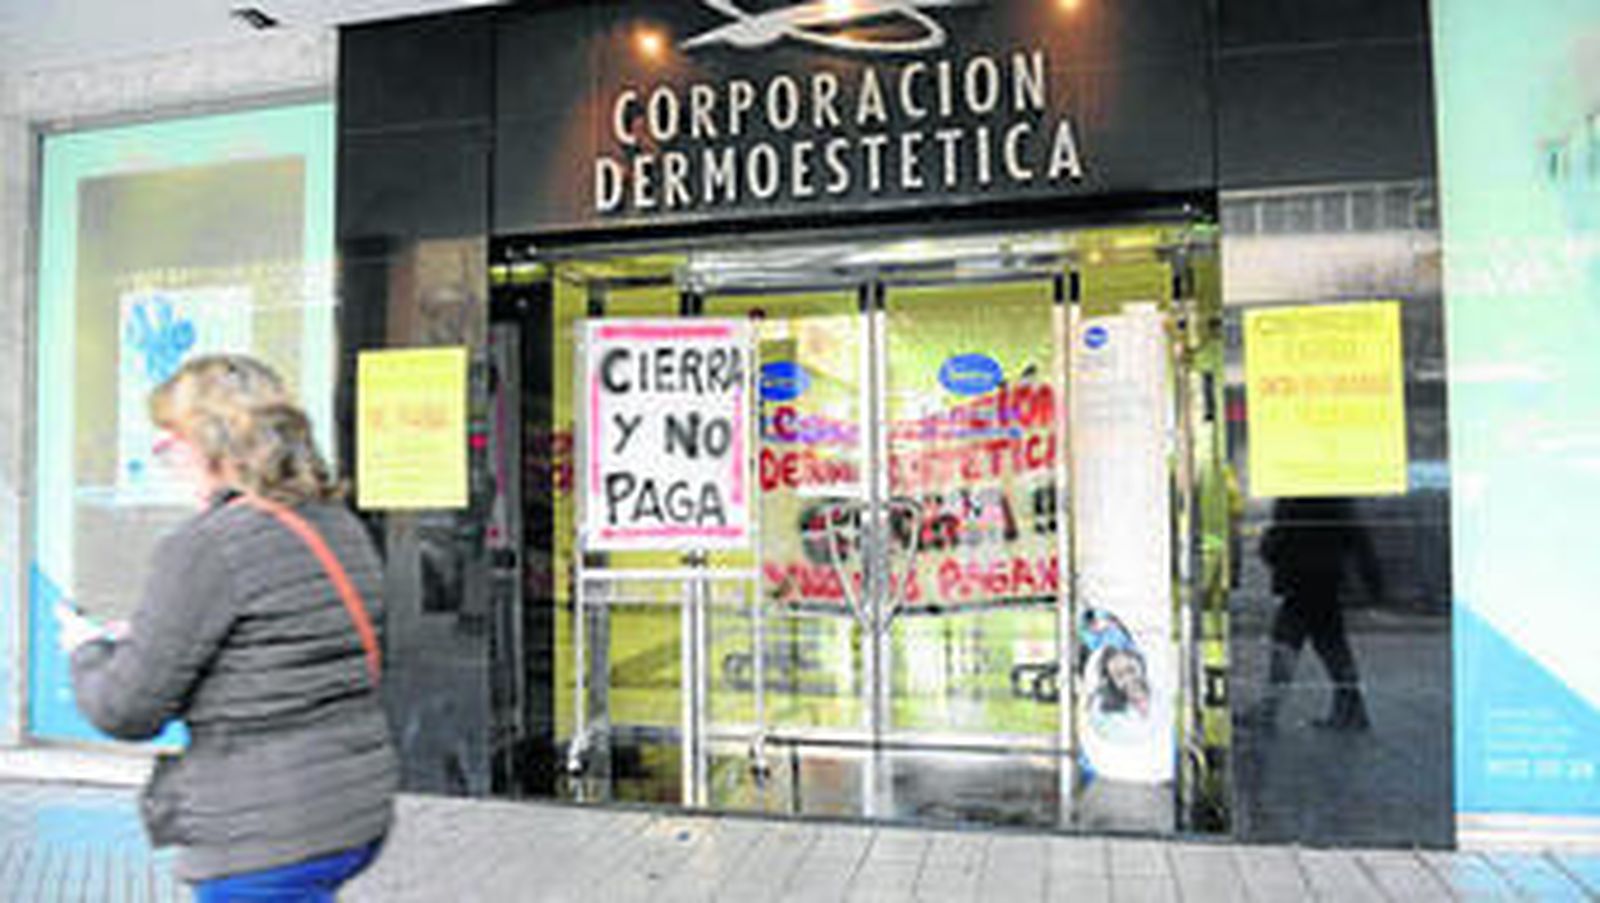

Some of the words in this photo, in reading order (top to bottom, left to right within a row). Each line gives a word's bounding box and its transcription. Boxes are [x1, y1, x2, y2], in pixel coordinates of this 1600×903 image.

[613, 51, 1047, 145] CORPORACION
[594, 119, 1084, 211] DERMOESTETICA
[601, 347, 743, 394] CIERRA
[613, 412, 642, 455] Y
[664, 411, 732, 459] NO
[605, 471, 727, 526] PAGA
